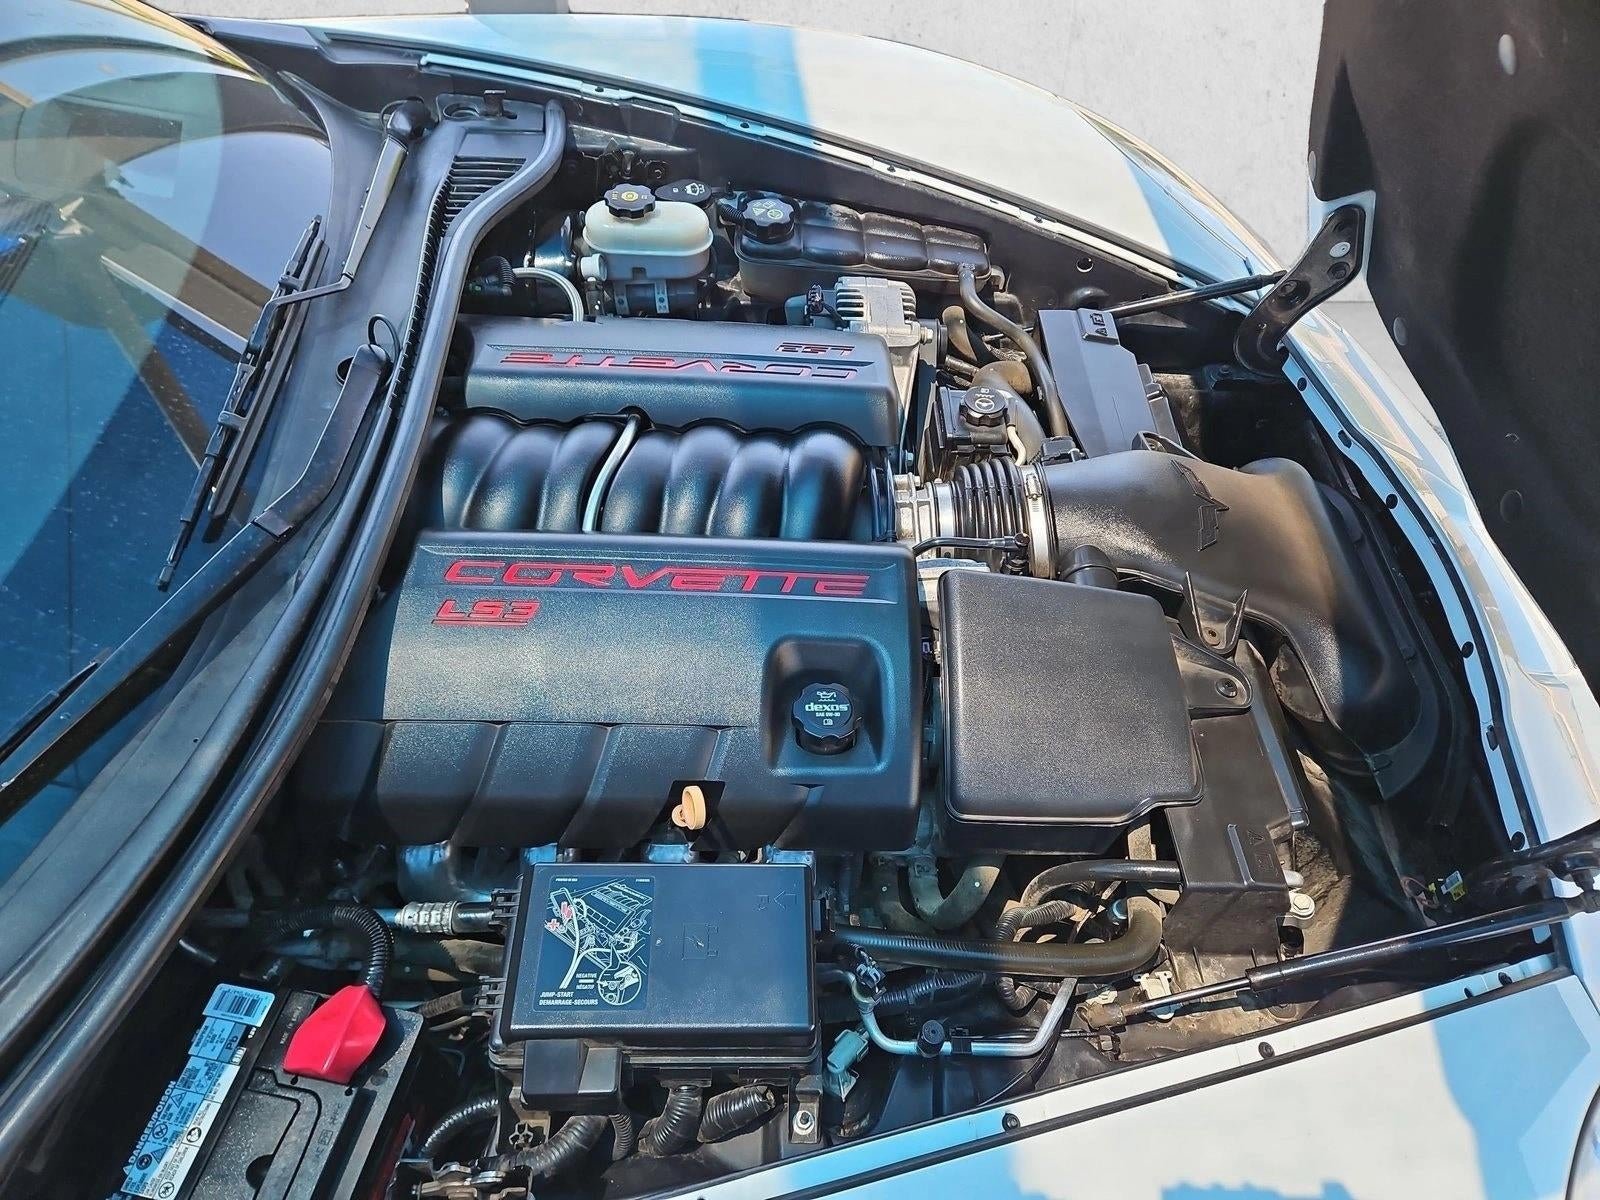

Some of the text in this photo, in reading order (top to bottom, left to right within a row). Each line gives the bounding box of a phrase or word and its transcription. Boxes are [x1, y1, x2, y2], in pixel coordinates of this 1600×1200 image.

[500, 351, 858, 379] CORVETTE
[444, 559, 869, 595] CORVETTE
[432, 599, 541, 626] LS3
[804, 702, 849, 712] dexos
[224, 1034, 239, 1050] Pb
[127, 1079, 176, 1163] DANGER/POISON
